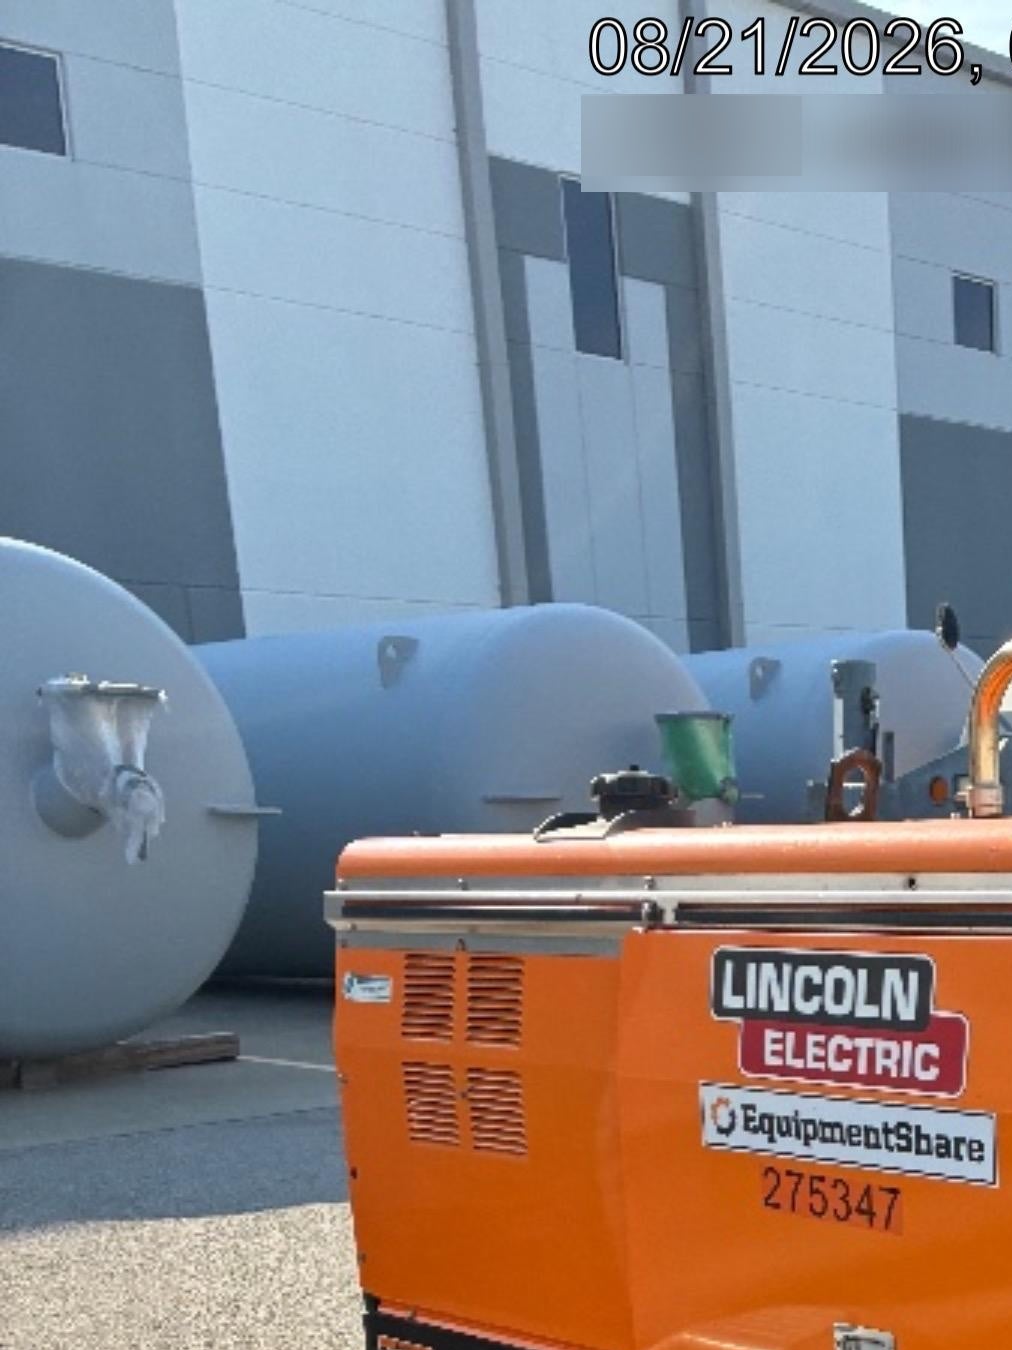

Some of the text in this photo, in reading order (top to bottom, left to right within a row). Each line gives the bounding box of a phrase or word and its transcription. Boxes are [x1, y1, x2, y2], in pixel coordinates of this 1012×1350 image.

[722, 959, 919, 1021] LINCOLN
[764, 1029, 940, 1081] ELECTRIC
[741, 1103, 986, 1163] EquipmentShare
[762, 1166, 901, 1230] 275347
